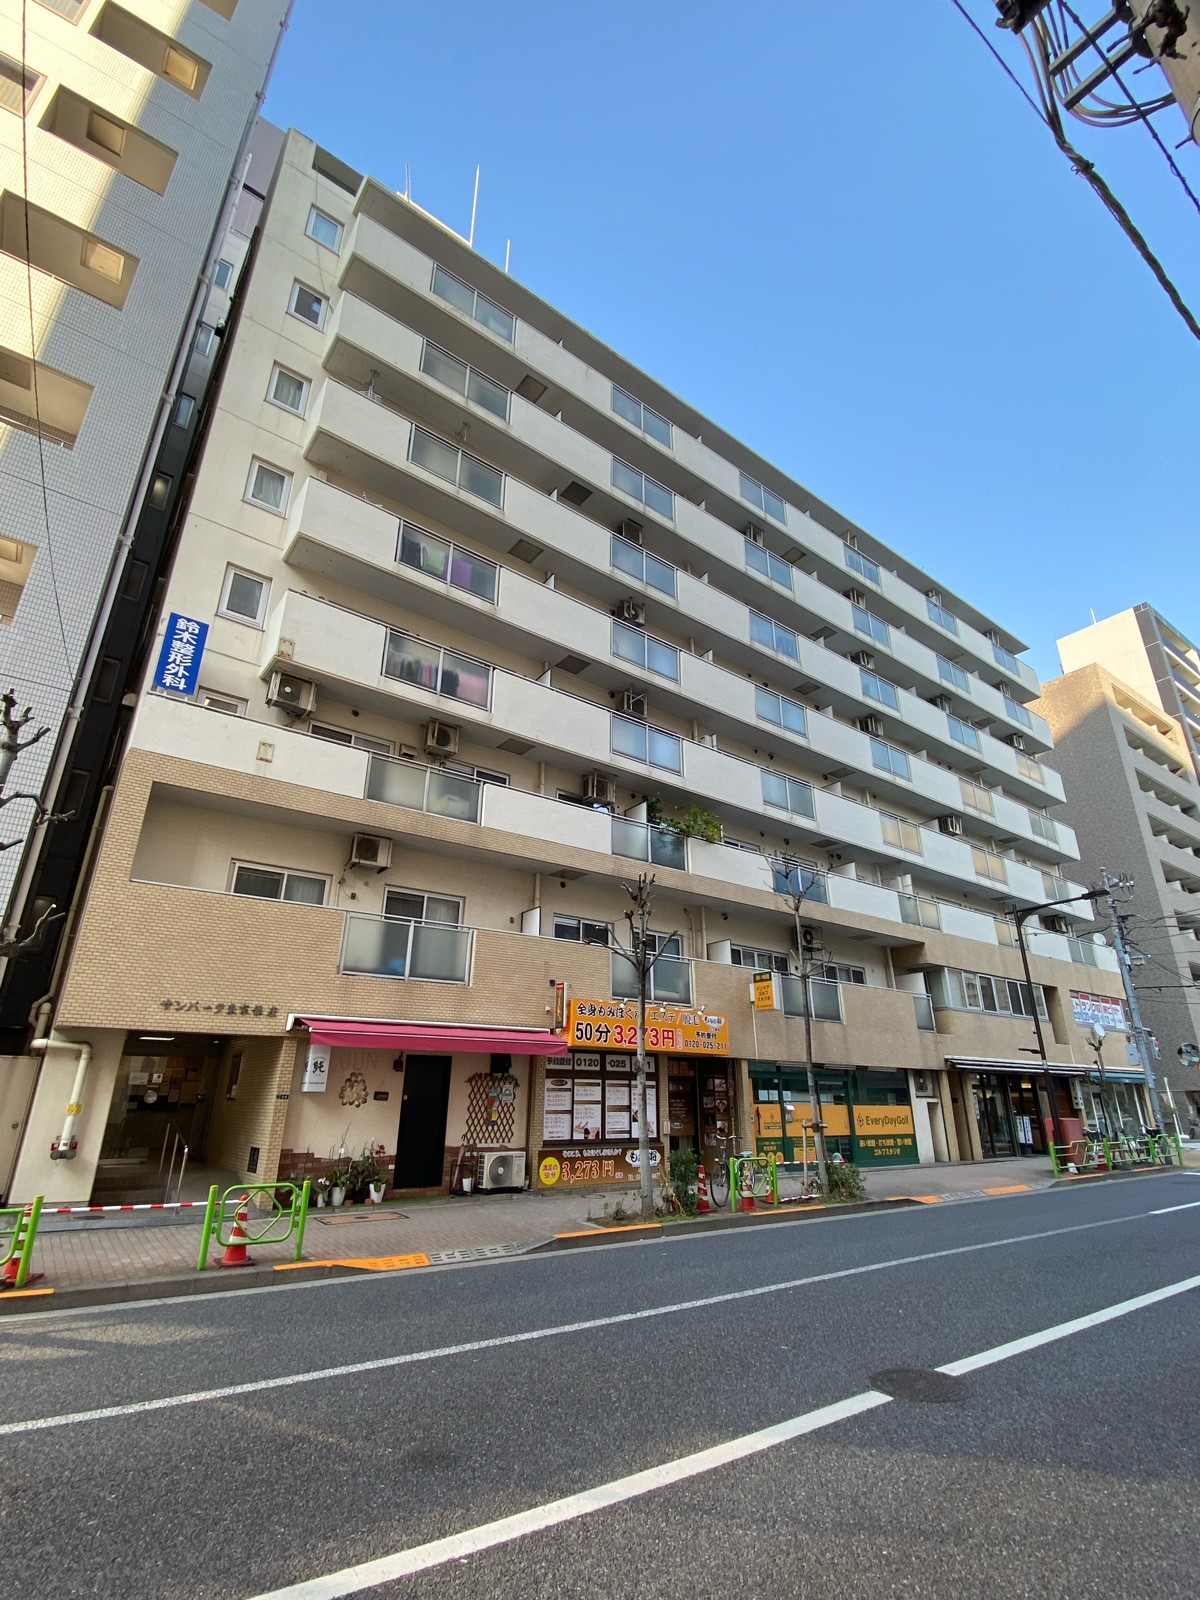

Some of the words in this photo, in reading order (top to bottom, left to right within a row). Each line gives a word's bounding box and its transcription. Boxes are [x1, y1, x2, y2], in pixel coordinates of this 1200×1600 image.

[162, 618, 200, 690] 鈴木整形外科
[575, 1022, 612, 1043] 50分
[575, 1057, 600, 1067] 0120
[561, 1160, 615, 1184] 3,273円
